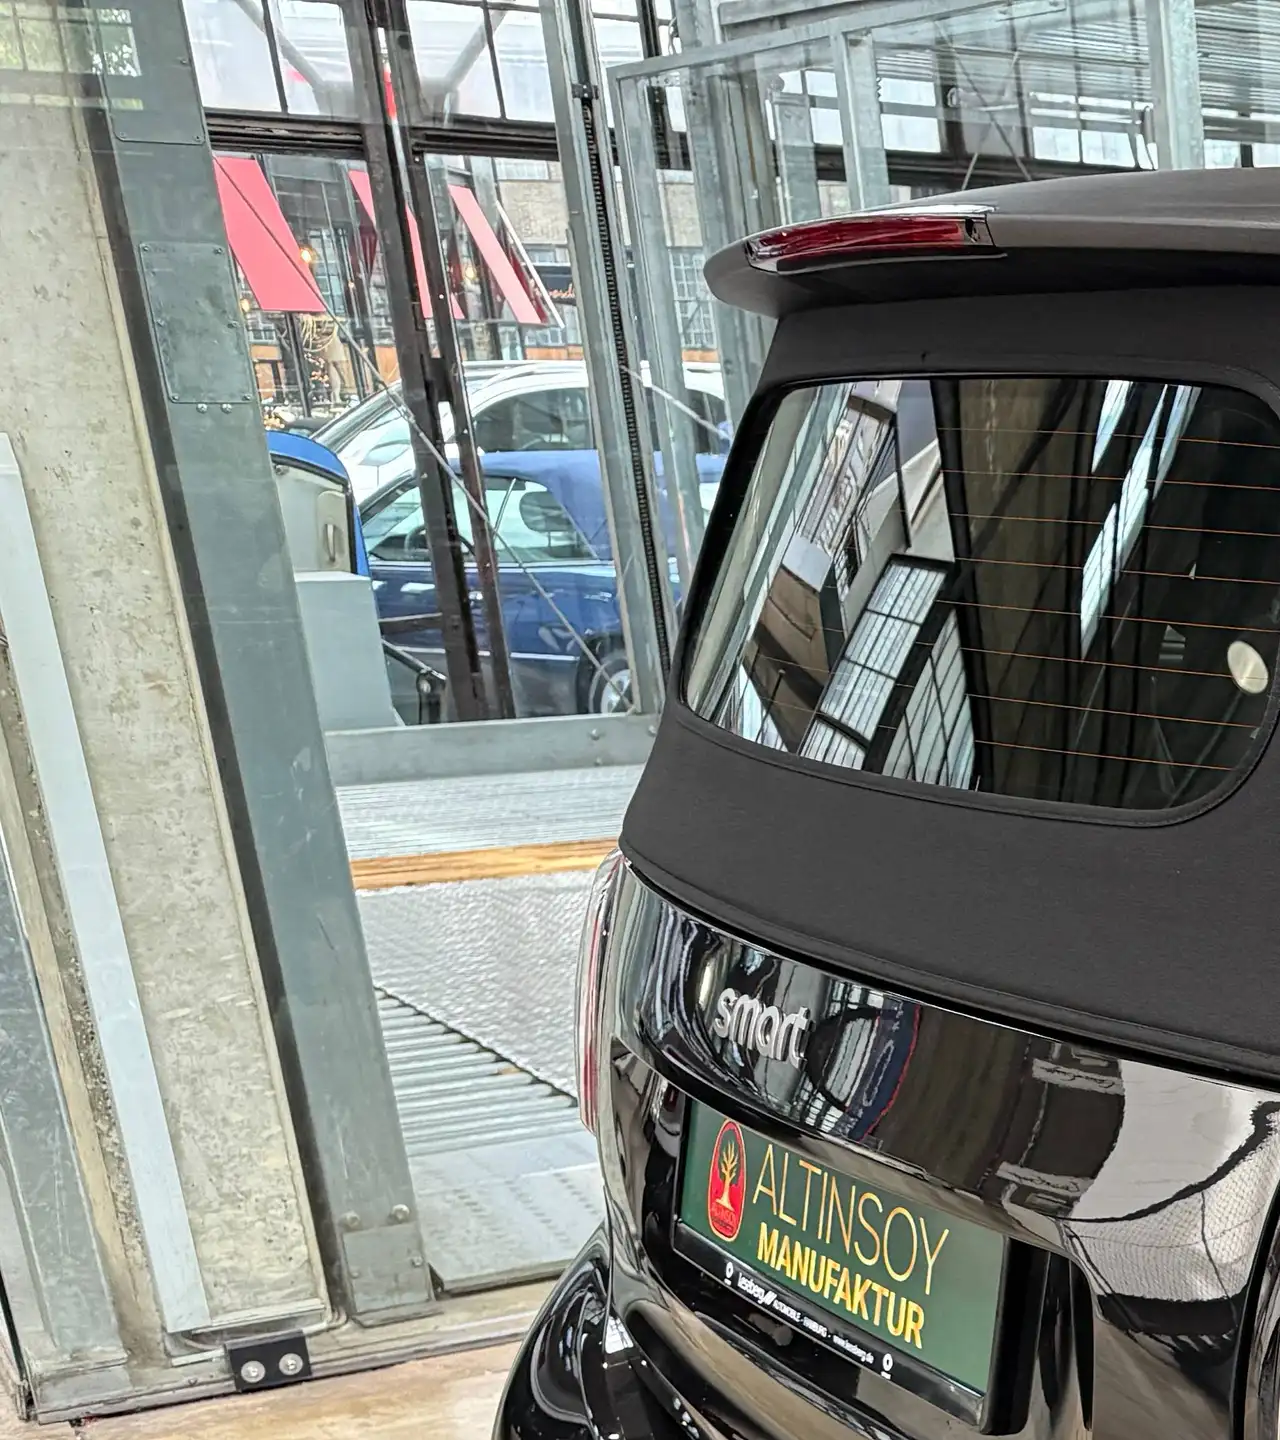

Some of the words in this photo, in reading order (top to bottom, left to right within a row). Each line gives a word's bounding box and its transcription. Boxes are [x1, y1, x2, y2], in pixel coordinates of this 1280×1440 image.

[713, 987, 809, 1068] smart
[753, 1143, 949, 1295] ALTINSOY
[757, 1222, 925, 1349] MANUFAKTUR
